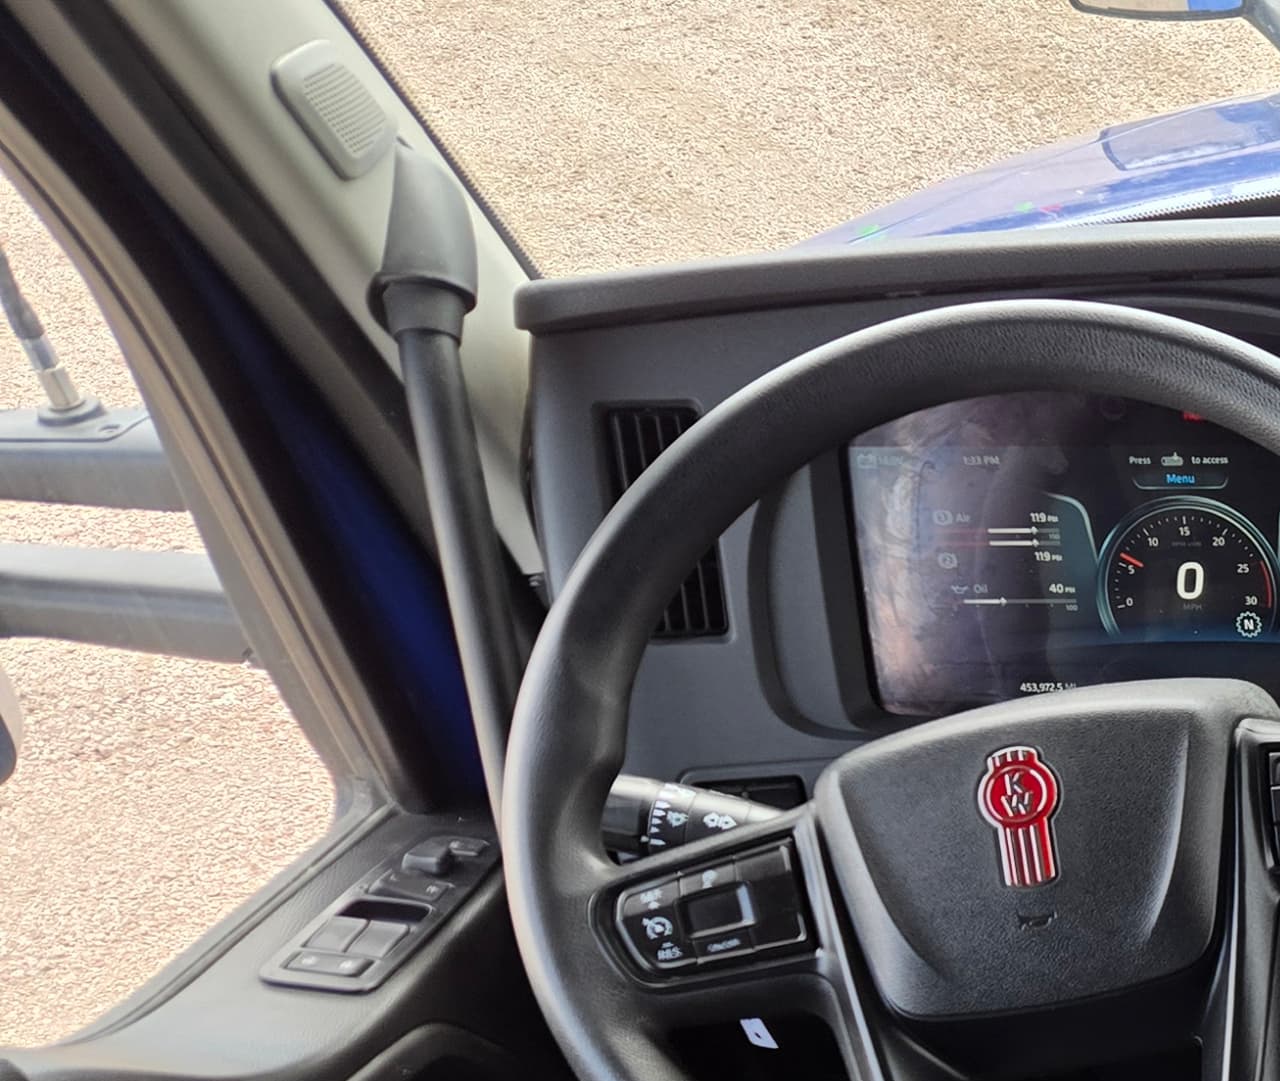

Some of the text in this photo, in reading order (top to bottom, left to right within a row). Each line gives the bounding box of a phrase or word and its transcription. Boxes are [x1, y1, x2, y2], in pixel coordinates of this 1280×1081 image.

[1129, 456, 1151, 465] Press
[1191, 456, 1201, 464] to
[1166, 474, 1195, 484] Menu
[955, 514, 971, 523] Air
[1029, 512, 1047, 523] 119
[1179, 527, 1191, 537] 15
[1148, 537, 1159, 547] 10
[1212, 537, 1225, 547] 20
[1034, 551, 1051, 562] 119
[1128, 565, 1135, 575] 5
[1236, 563, 1250, 574] 25
[1177, 561, 1204, 600] 0
[973, 584, 988, 593] Oil
[1049, 583, 1064, 594] 40
[1126, 598, 1133, 607] 0
[1244, 596, 1258, 606] 30
[1066, 604, 1078, 612] 100
[1244, 619, 1254, 631] N
